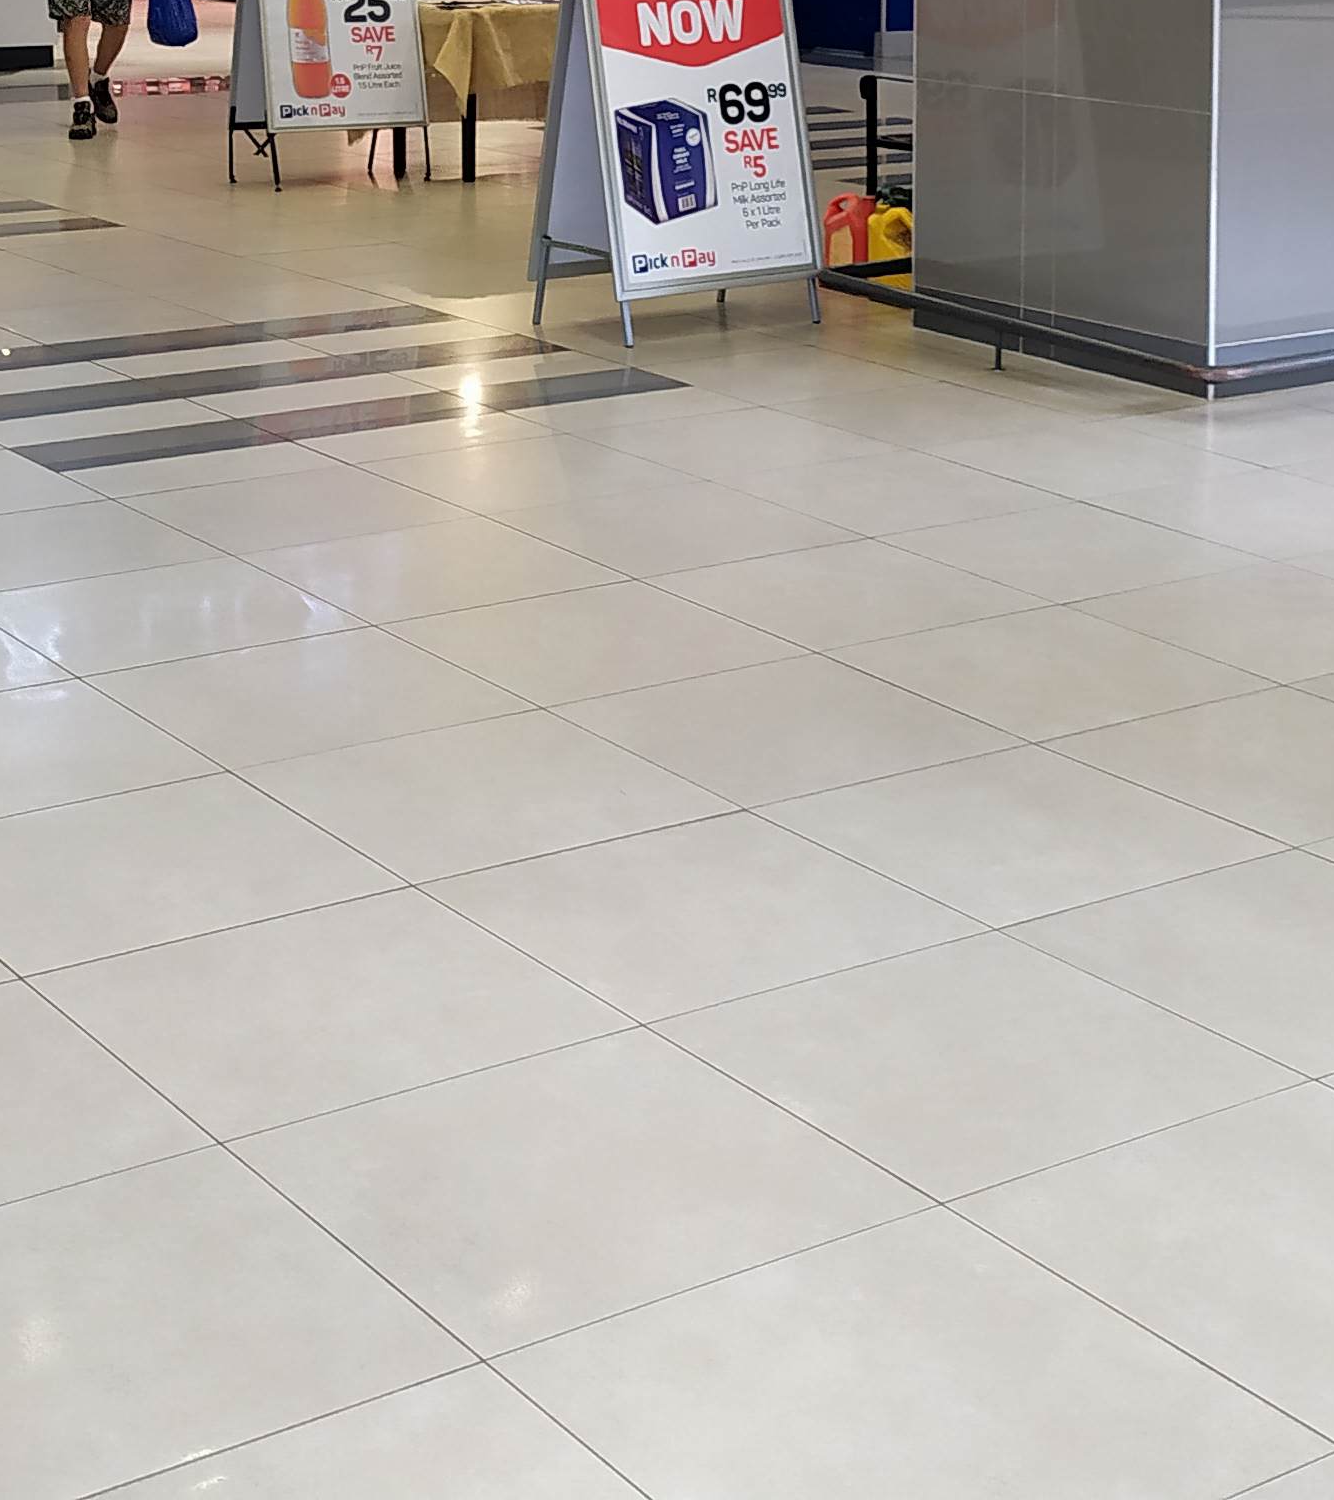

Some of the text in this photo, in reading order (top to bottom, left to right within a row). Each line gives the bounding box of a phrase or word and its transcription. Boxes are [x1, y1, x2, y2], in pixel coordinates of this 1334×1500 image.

[351, 25, 396, 43] SAVE
[366, 45, 383, 62] R7
[280, 102, 309, 119] Pick
[311, 106, 318, 116] n
[319, 103, 346, 117] Pay
[724, 127, 780, 153] SAVE
[744, 155, 767, 178] R5
[731, 179, 786, 193] PnP Long Life
[732, 192, 786, 205] Milk Assorted
[762, 205, 781, 216] Litre
[746, 217, 781, 229] Per Pack
[632, 253, 668, 274] Pick
[671, 255, 680, 268] n
[682, 249, 716, 269] Pay
